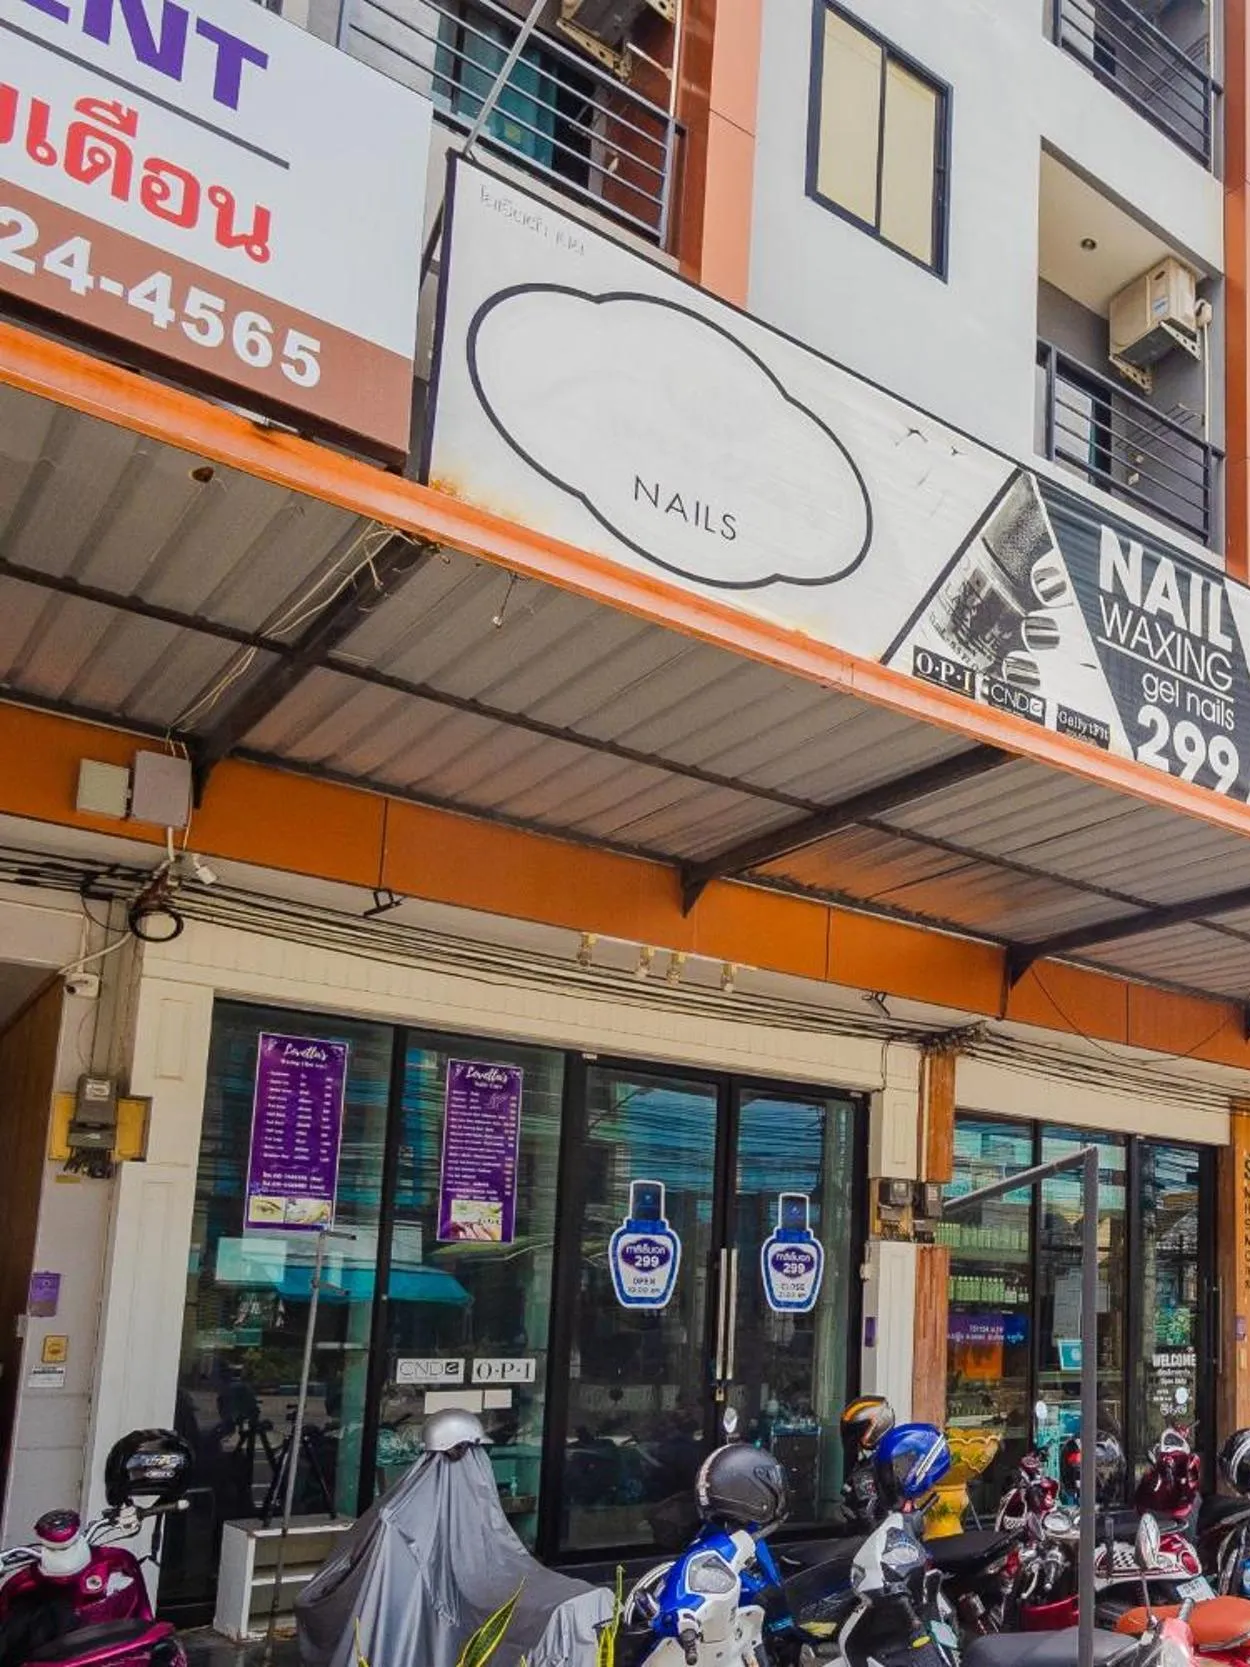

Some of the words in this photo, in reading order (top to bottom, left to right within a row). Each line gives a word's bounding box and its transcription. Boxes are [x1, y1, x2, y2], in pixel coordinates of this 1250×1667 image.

[20, 0, 269, 111] NT
[0, 205, 322, 388] 24-4565
[634, 475, 737, 541] NAILS
[1099, 526, 1233, 652] NAIL
[1099, 595, 1233, 693] WAXING
[1141, 672, 1180, 706] gel
[1186, 688, 1235, 731] nails
[1137, 705, 1240, 795] 299
[635, 1255, 659, 1268] 299
[1152, 1353, 1196, 1367] WELCOME
